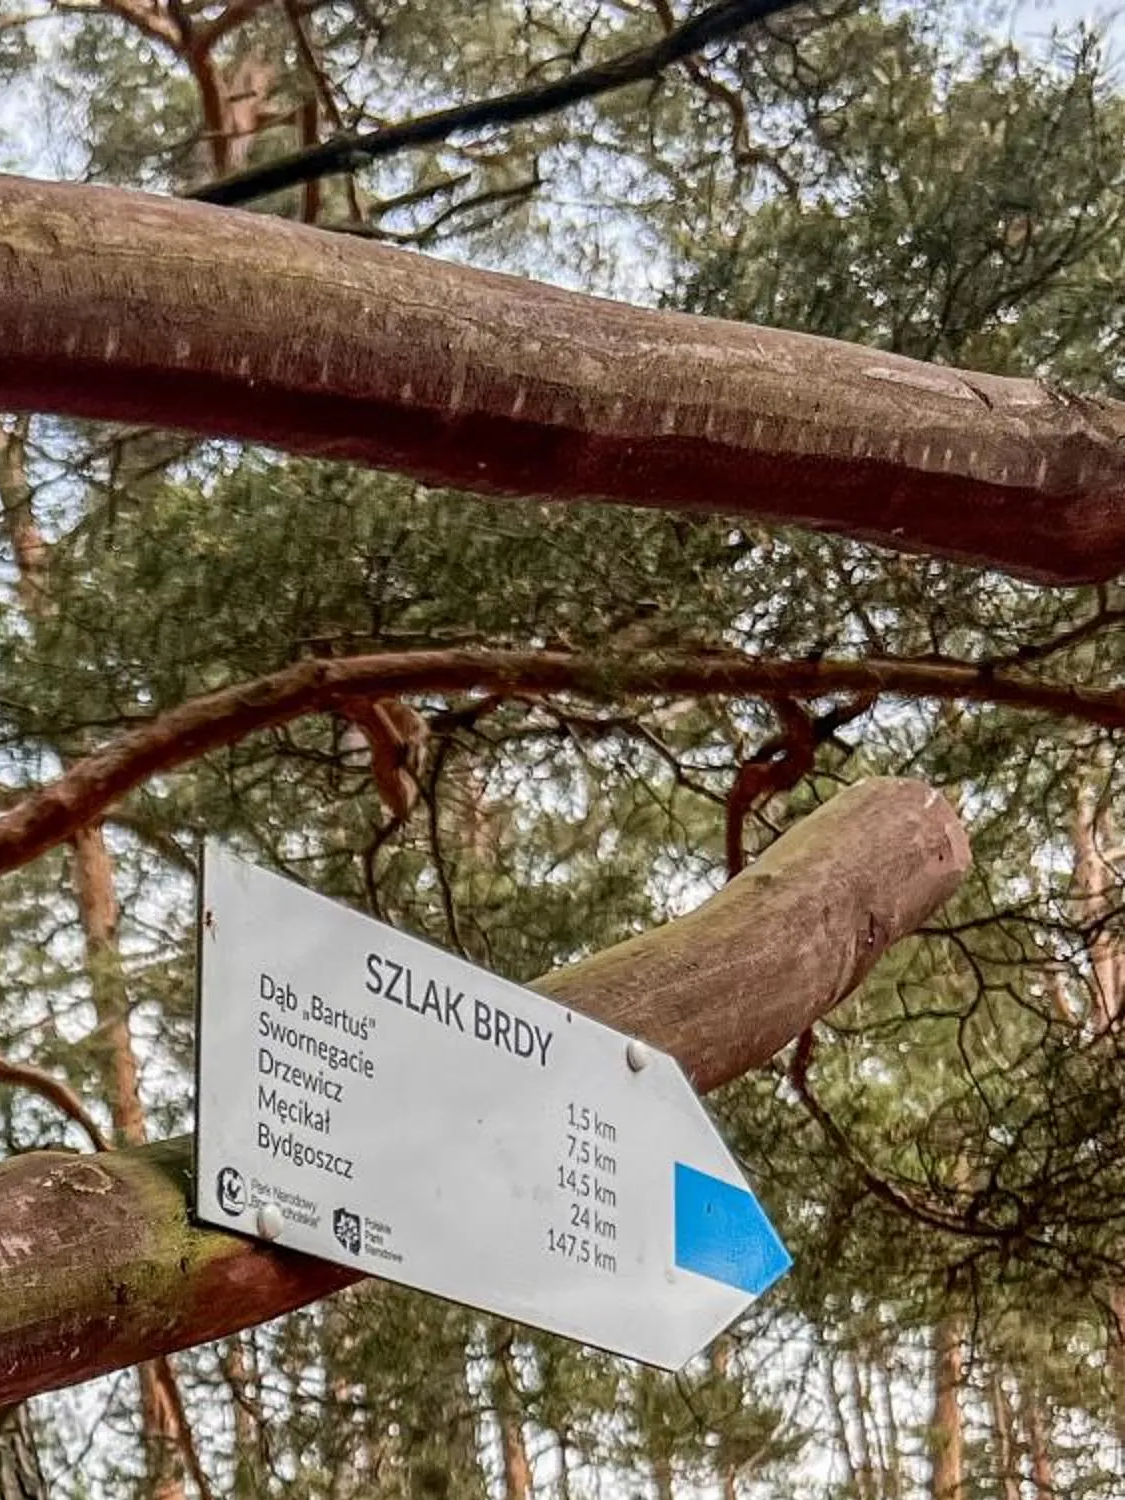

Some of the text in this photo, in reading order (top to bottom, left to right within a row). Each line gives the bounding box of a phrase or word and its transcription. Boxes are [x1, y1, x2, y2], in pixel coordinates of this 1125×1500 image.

[260, 973, 297, 1012] Dąb
[366, 954, 553, 1066] SZLAK BRDY
[259, 1011, 374, 1079] Swornegacie
[259, 1048, 343, 1102] Drzewicz
[259, 1085, 330, 1134] Męcikał
[568, 1103, 616, 1142] 1,5 km
[258, 1123, 353, 1179] Bydgoszcz
[567, 1134, 616, 1175] 7,5 km
[558, 1165, 616, 1207] 14,5 km
[571, 1203, 616, 1240] 24 km
[548, 1228, 616, 1273] 147,5 km
